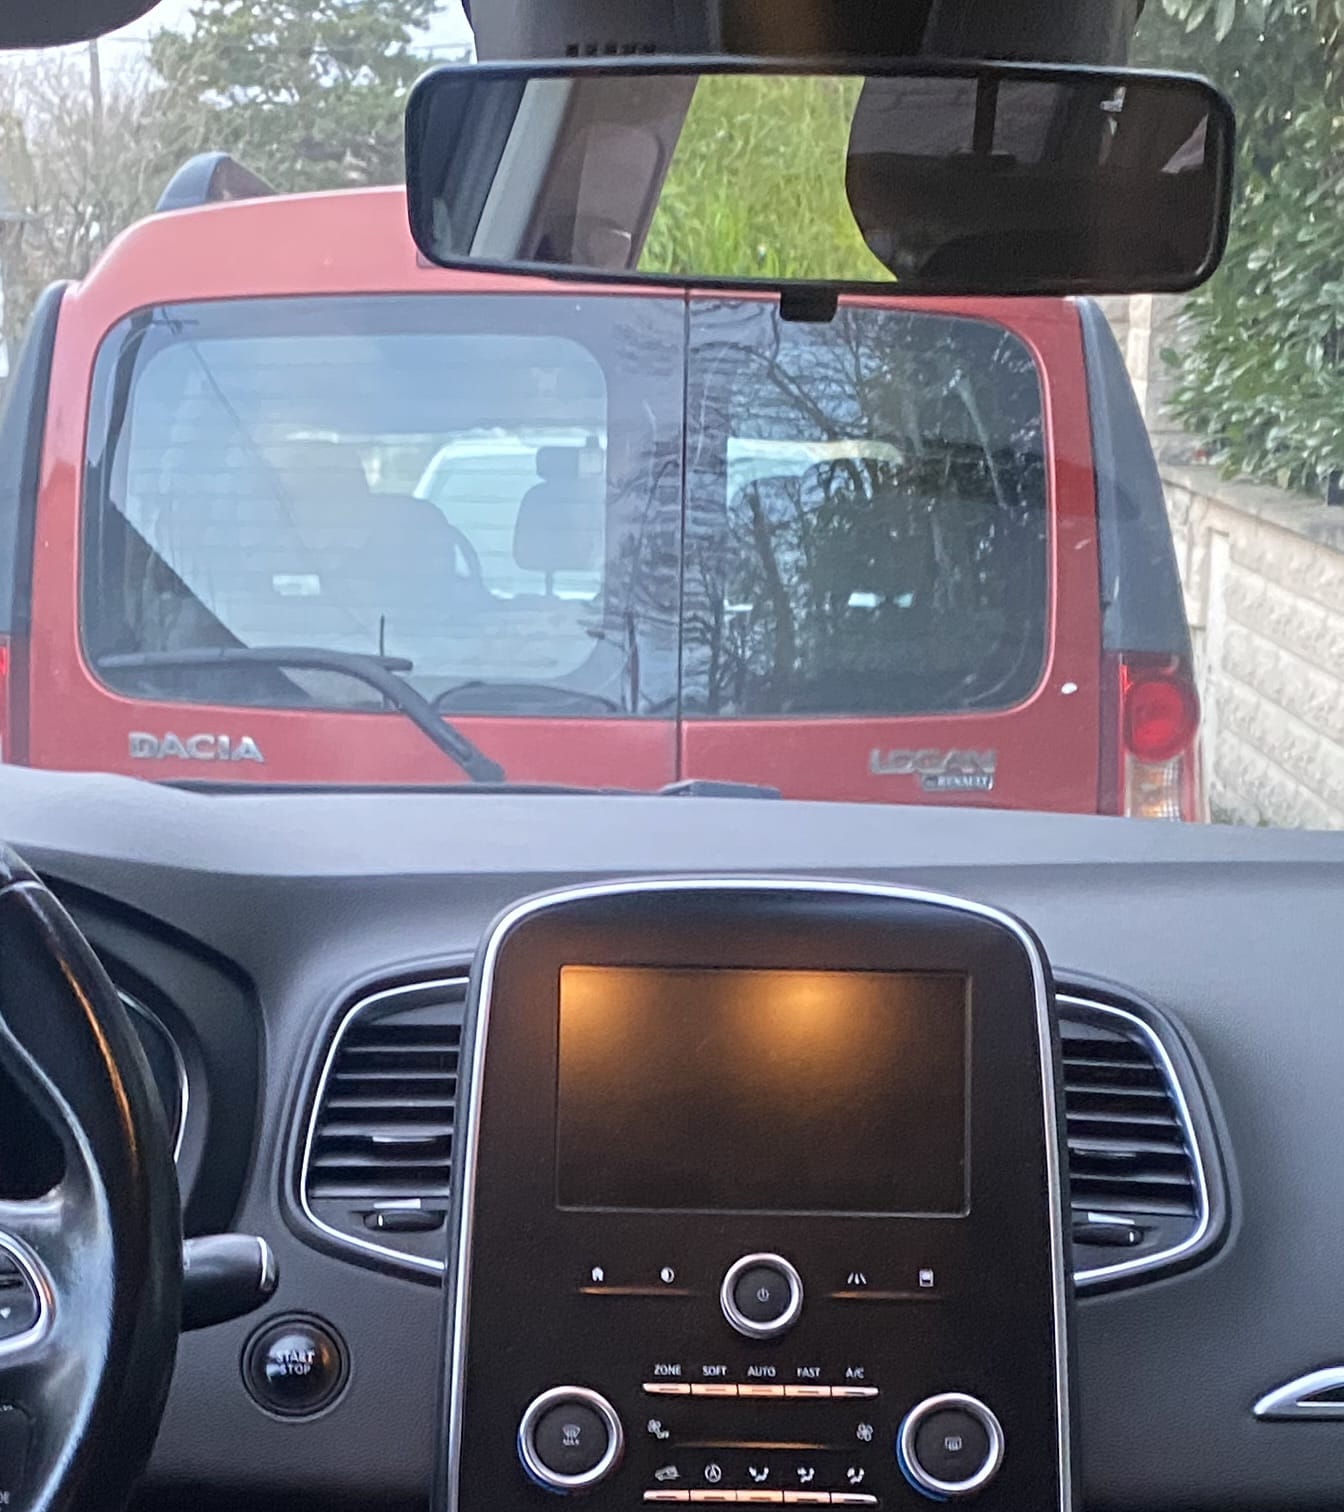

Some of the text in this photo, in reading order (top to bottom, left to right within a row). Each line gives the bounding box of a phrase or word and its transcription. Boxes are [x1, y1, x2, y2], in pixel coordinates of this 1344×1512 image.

[128, 731, 264, 763] DACIA
[276, 1350, 314, 1364] START
[279, 1363, 311, 1375] STOP
[654, 1364, 864, 1379] ZONE SOFT AUTO FAST A/C
